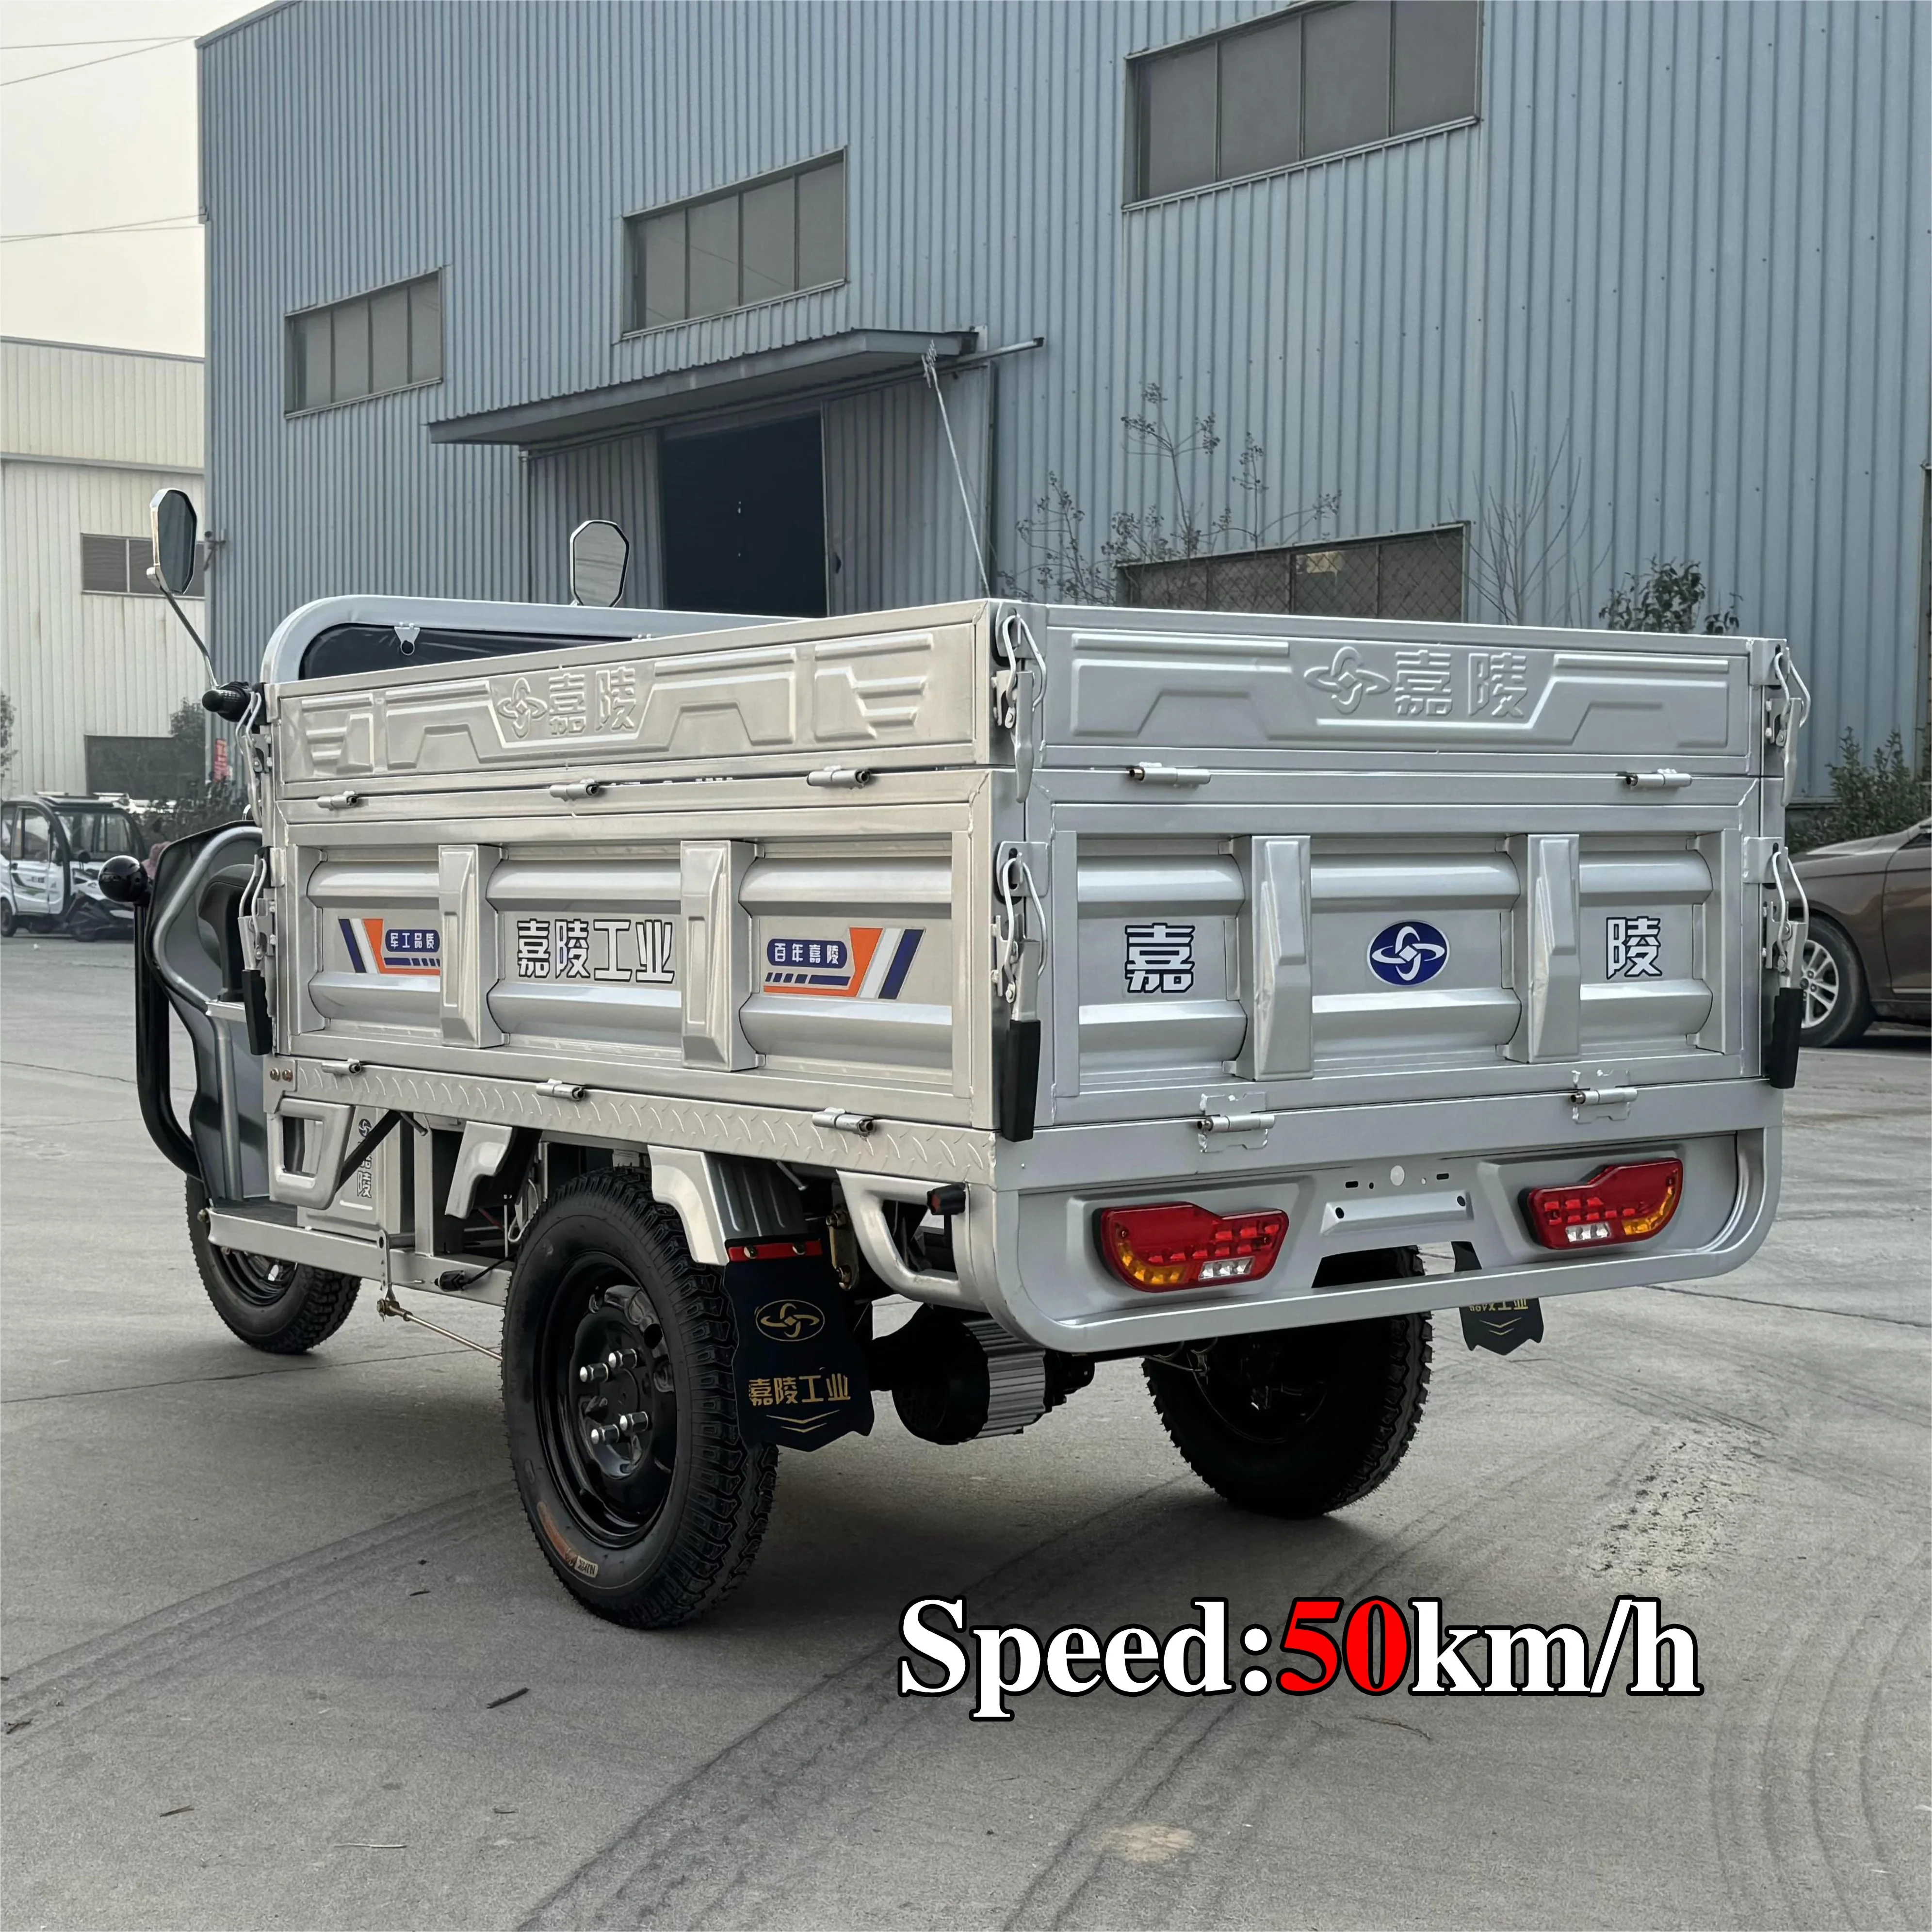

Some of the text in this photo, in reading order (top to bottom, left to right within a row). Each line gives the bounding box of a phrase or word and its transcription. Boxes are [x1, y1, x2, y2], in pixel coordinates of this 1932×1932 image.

[549, 666, 636, 735] 嘉陵
[1395, 649, 1527, 718] 嘉陵
[390, 932, 435, 949] 军工品质
[517, 918, 675, 983] 嘉陵工业
[774, 942, 839, 964] 百年嘉陵
[1124, 916, 1662, 993] 嘉 陵
[748, 1373, 851, 1406] 嘉陵工业
